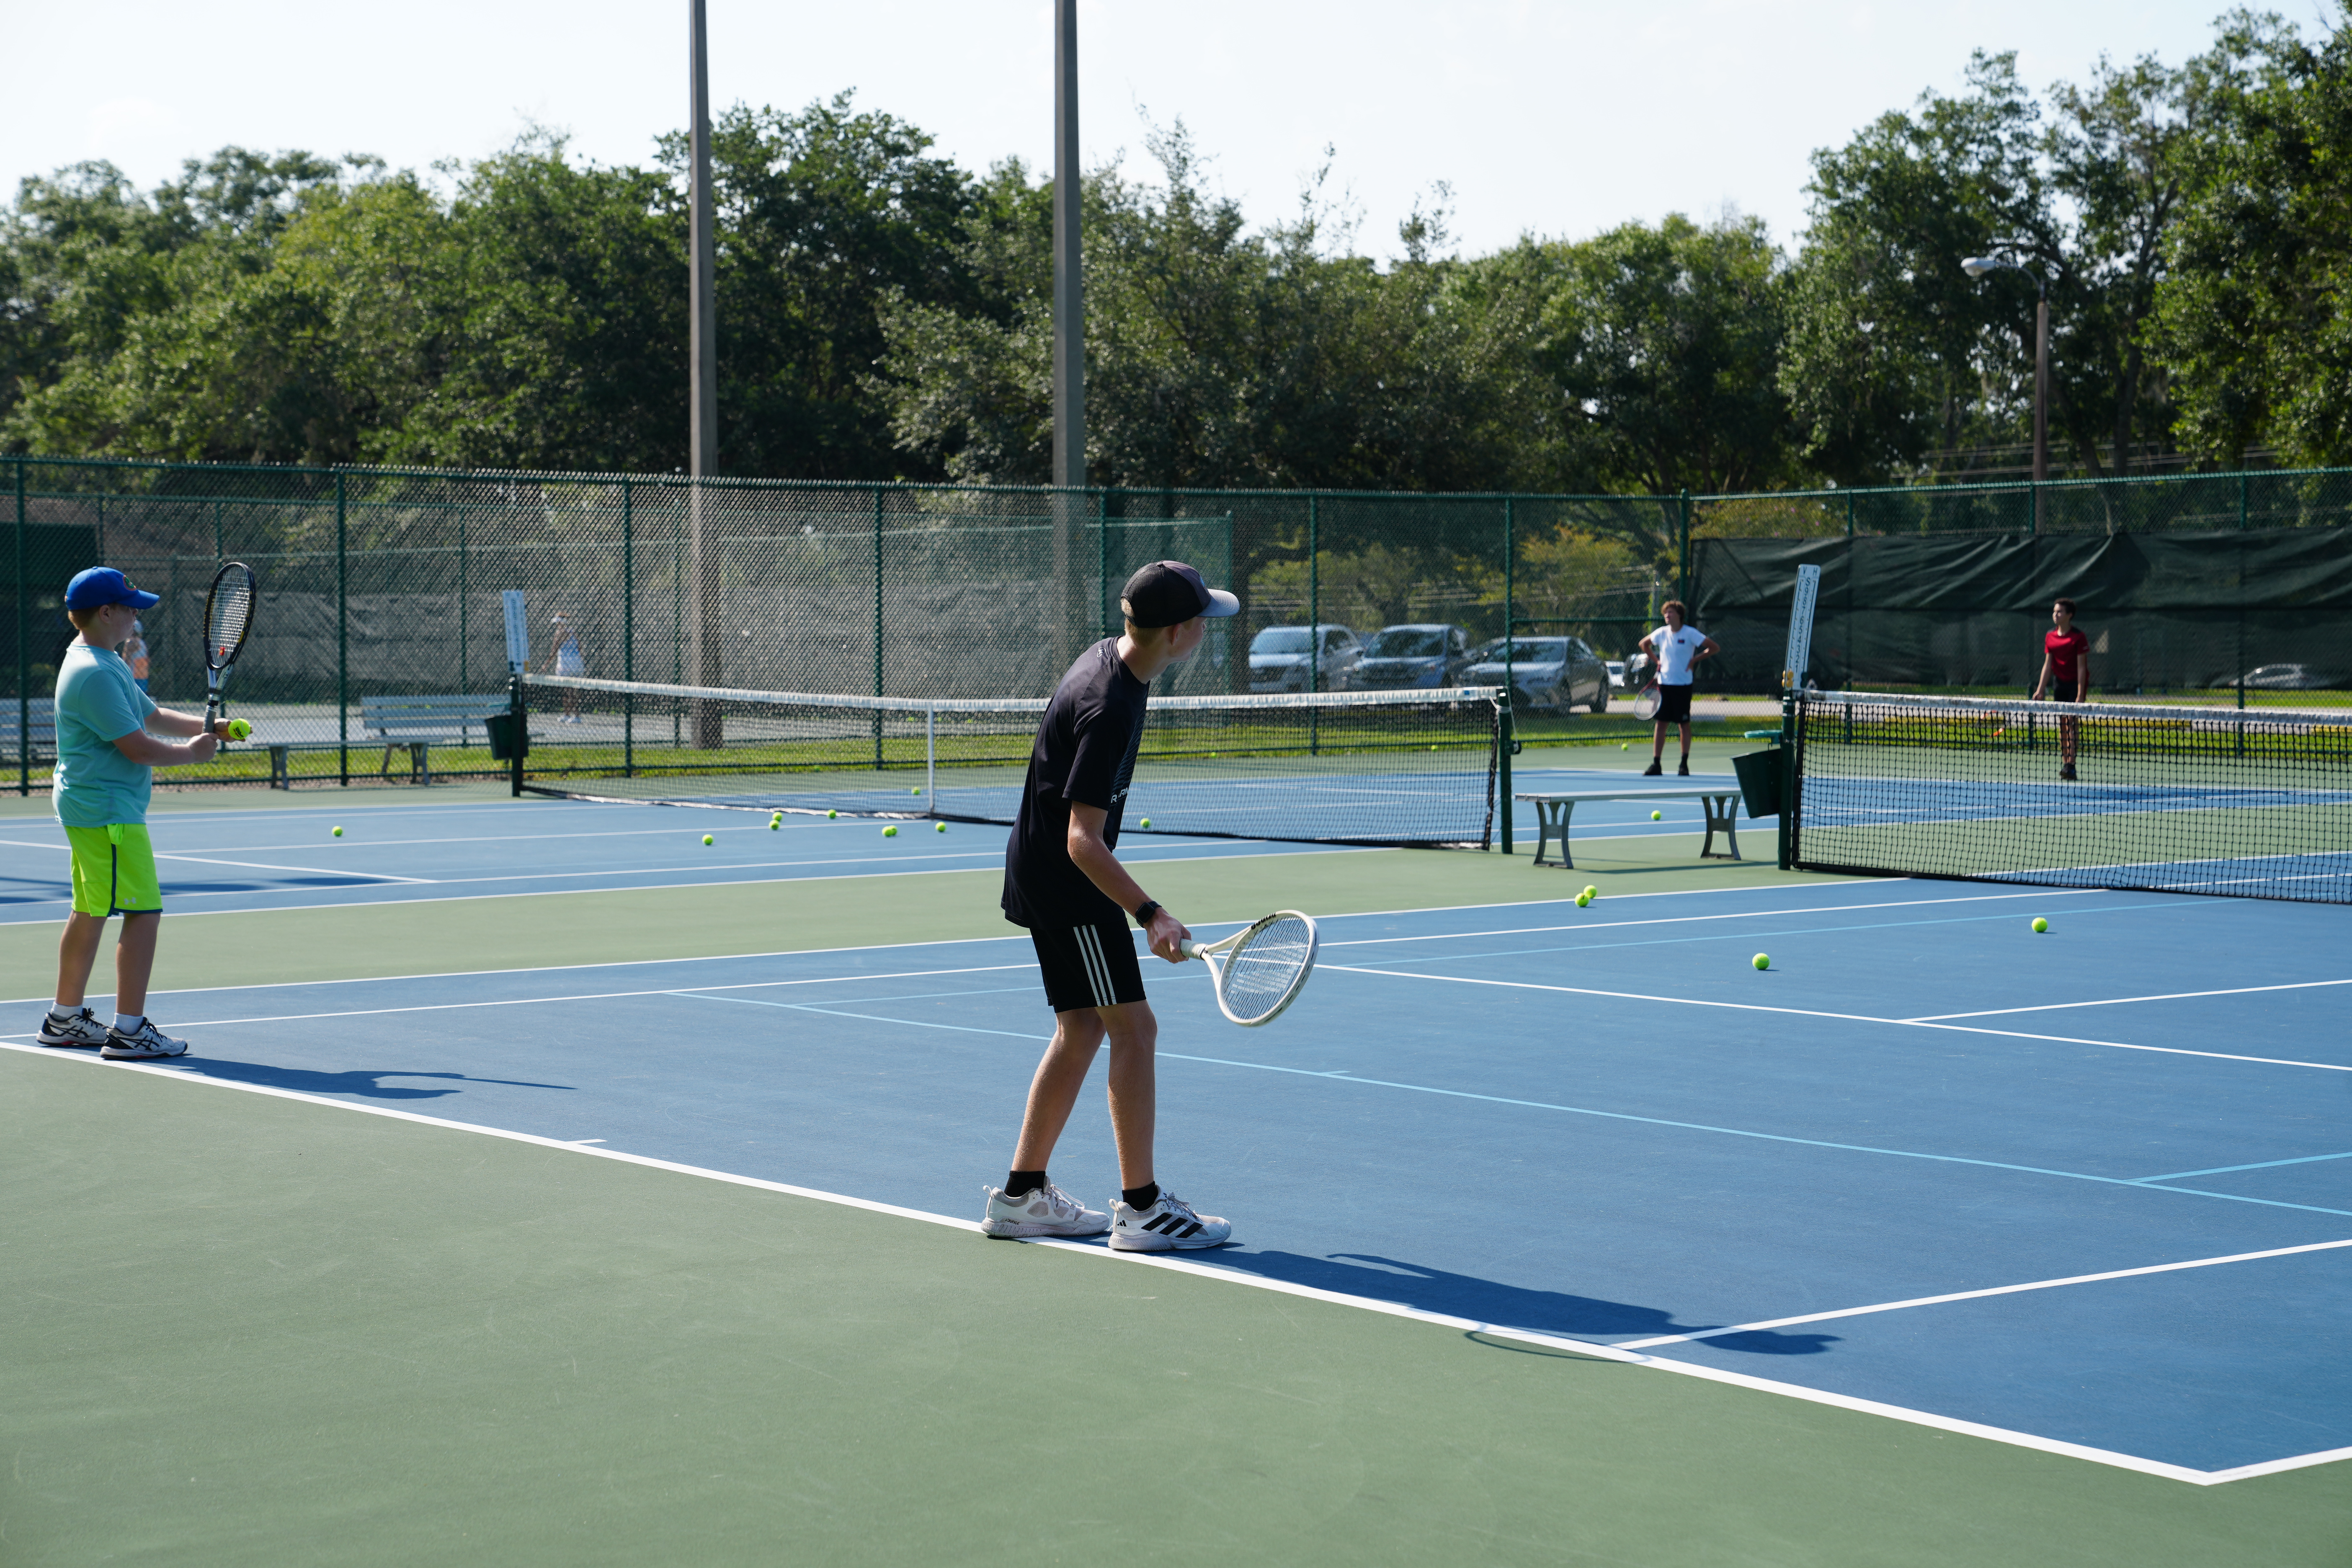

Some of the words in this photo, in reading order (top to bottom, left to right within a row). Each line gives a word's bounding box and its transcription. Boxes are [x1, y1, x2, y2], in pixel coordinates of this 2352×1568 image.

[1803, 566, 1808, 575] V
[1812, 567, 1818, 577] H
[1805, 577, 1810, 586] S
